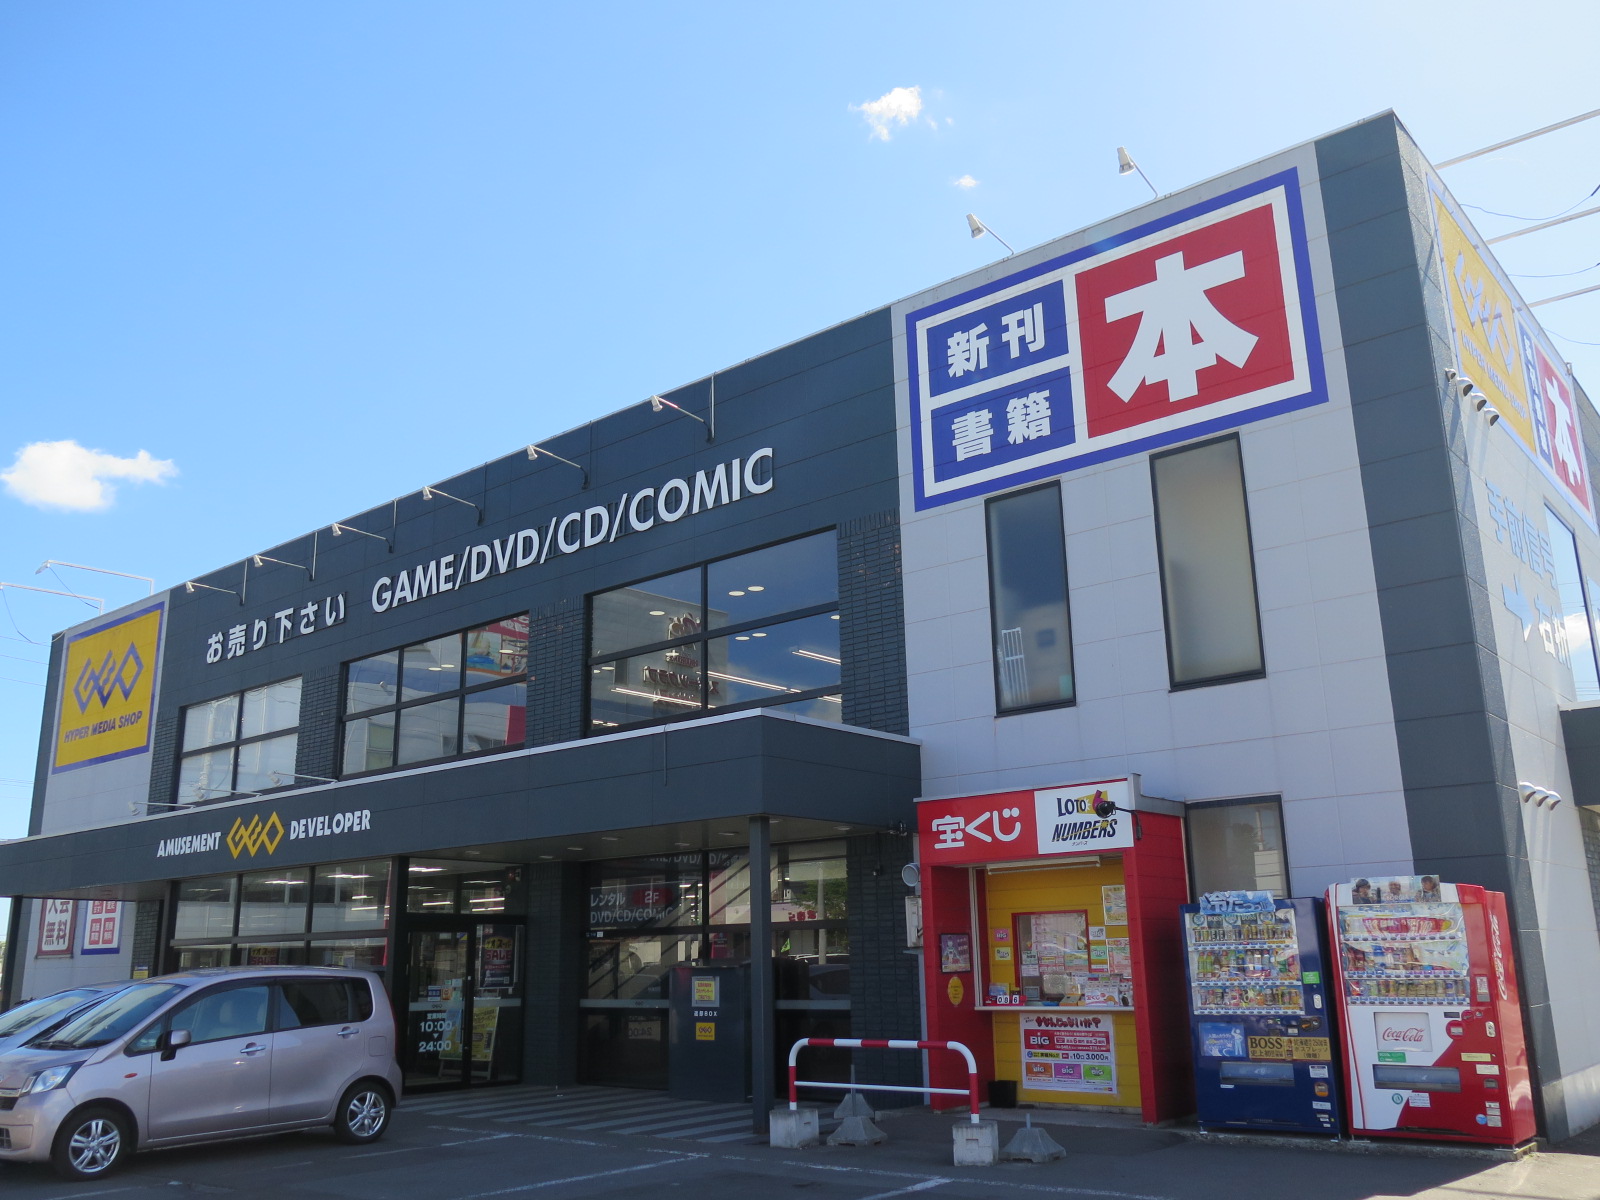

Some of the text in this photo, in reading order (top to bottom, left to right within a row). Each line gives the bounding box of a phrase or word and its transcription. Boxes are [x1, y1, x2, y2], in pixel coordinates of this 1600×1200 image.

[947, 301, 1046, 378] 新刊
[1104, 251, 1259, 403] 本
[951, 390, 1051, 462] 書籍
[1545, 376, 1581, 487] 本
[206, 447, 774, 665] お売り下さい GAME/DVD/CD/COMIC
[64, 710, 143, 743] HYPER MEDIA SHOP
[157, 831, 221, 858] AMUSEMENT
[290, 809, 371, 841] DEVELOPER
[932, 807, 1021, 849] 宝くじ
[1052, 818, 1117, 843] NUMBERS
[591, 890, 660, 907] レンタル 2F
[44, 920, 68, 946] 無料
[420, 1021, 452, 1032] 10:00
[1030, 1032, 1050, 1045] BIG
[1382, 1027, 1424, 1043] Coca-Cola
[418, 1041, 452, 1052] 24:00
[1249, 1037, 1283, 1049] BOSS
